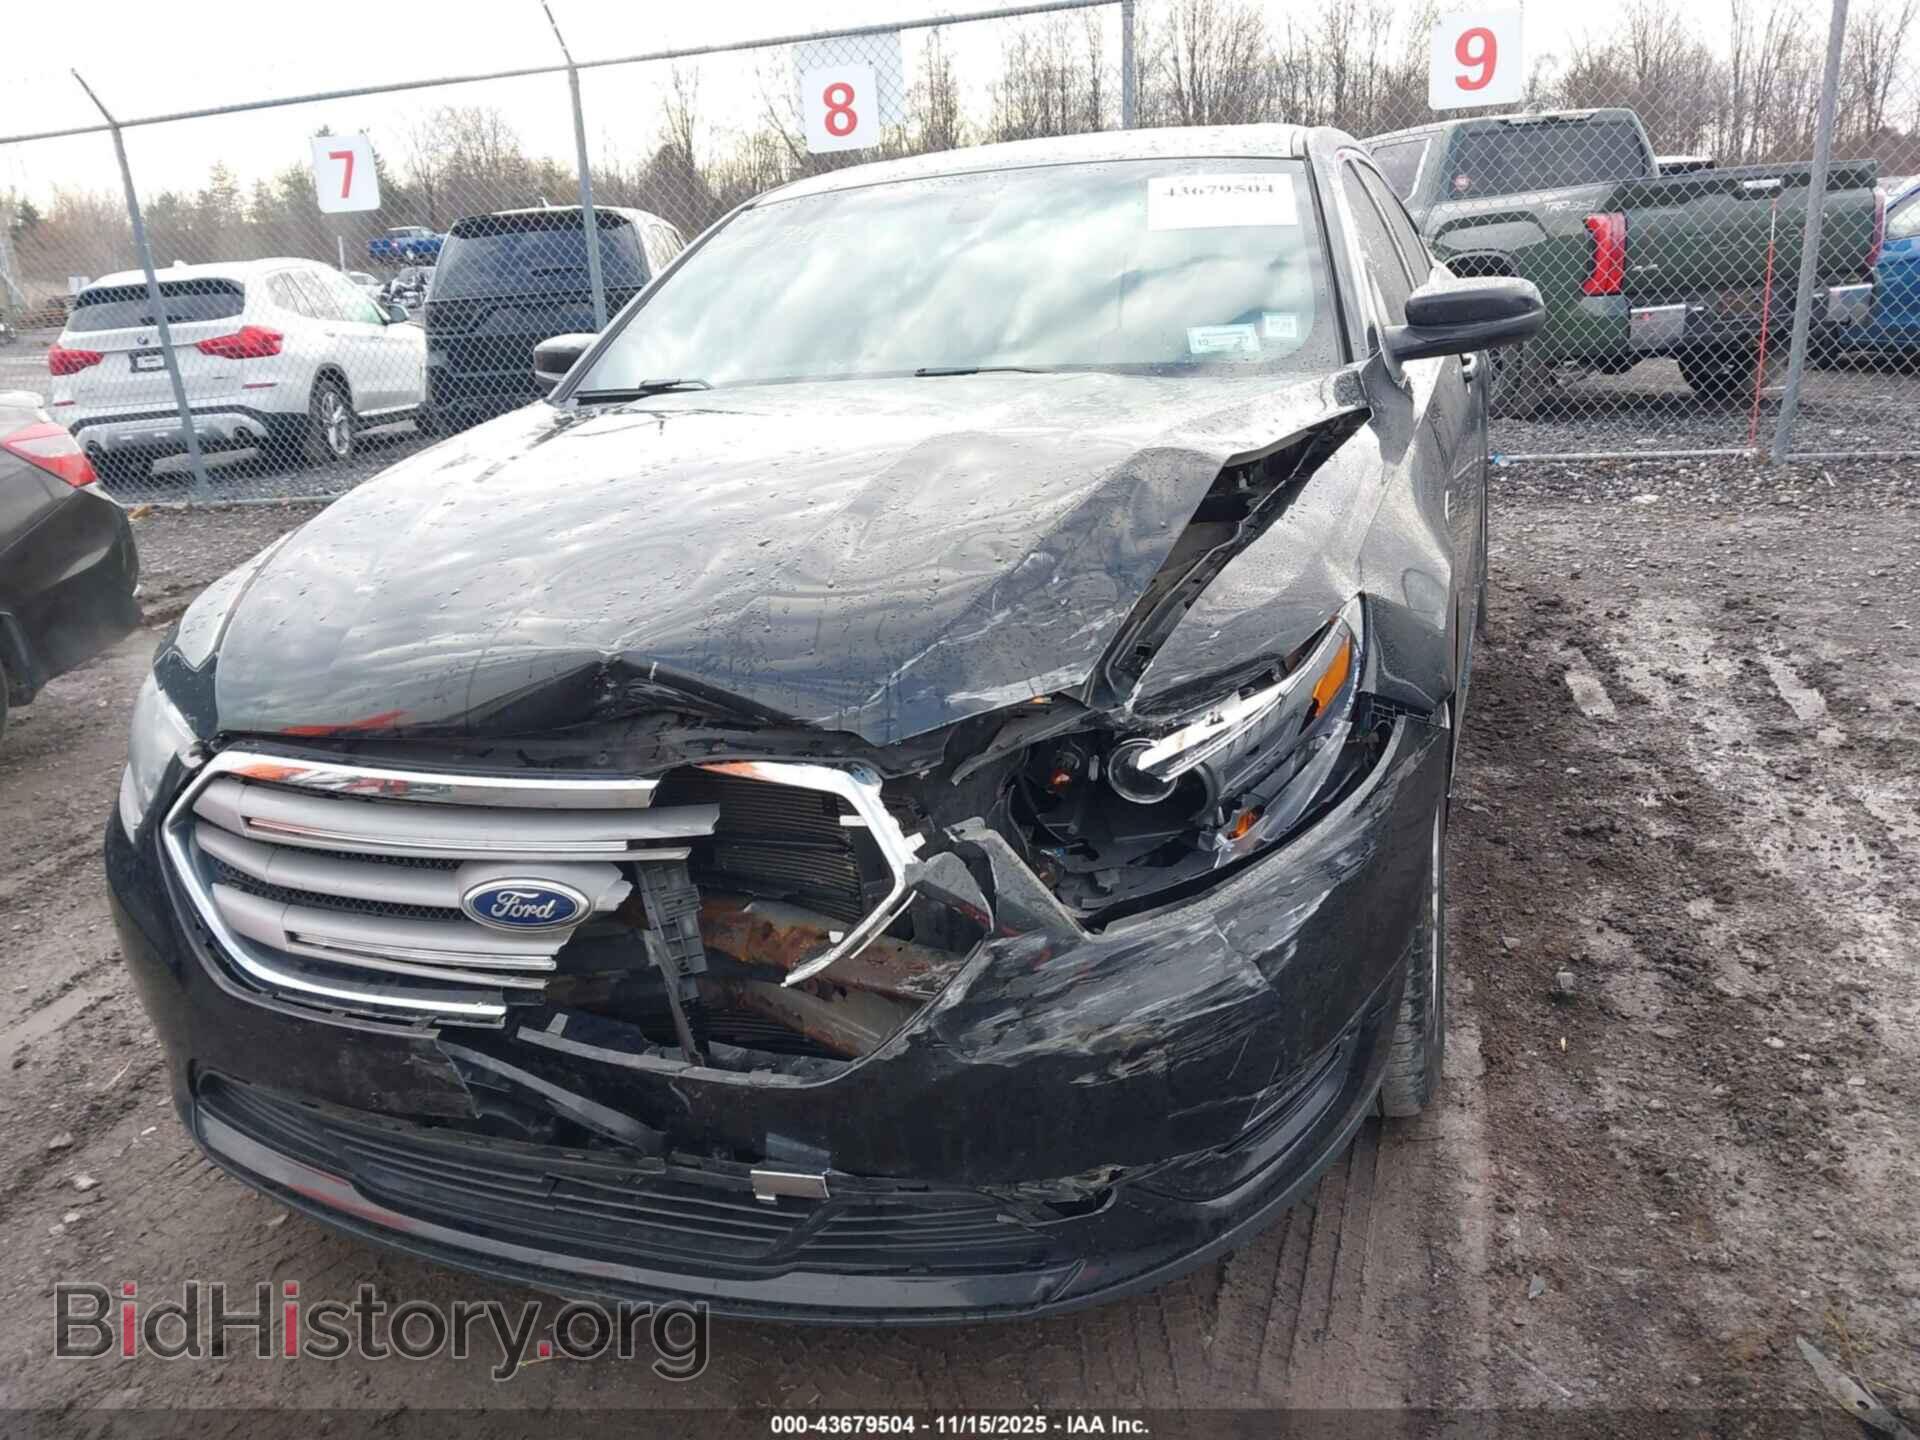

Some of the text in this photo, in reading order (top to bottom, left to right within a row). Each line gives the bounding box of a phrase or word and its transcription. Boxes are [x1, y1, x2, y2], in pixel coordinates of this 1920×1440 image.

[1455, 27, 1497, 91] 9
[823, 82, 857, 136] 8
[328, 150, 354, 198] 7
[490, 890, 556, 919] Ford
